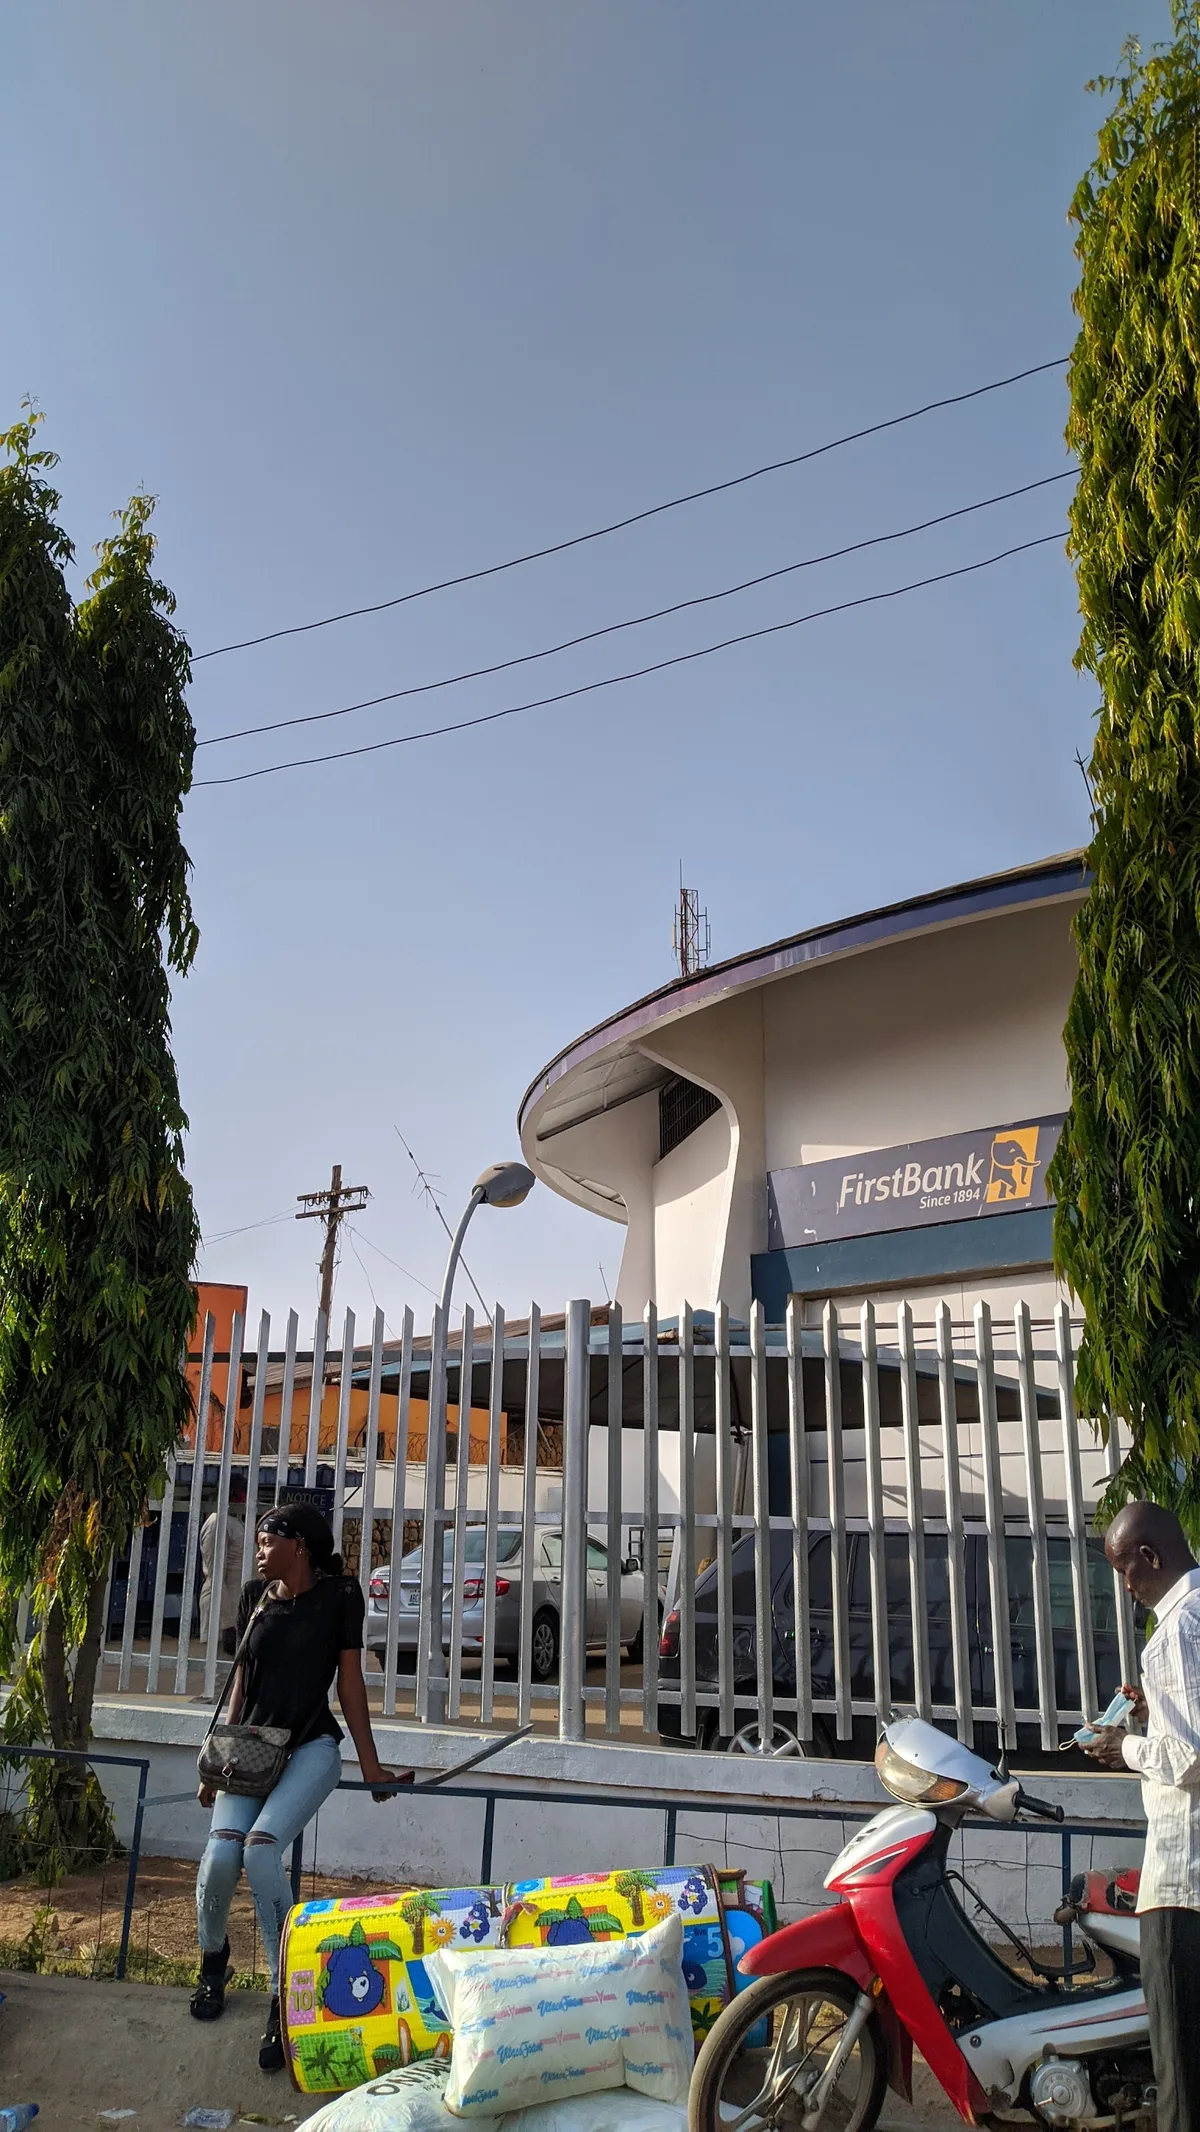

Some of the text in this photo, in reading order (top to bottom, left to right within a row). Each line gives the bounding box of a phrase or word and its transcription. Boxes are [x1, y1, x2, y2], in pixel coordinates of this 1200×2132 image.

[839, 1152, 985, 1208] FirstBank
[919, 1188, 981, 1209] Since 1894
[286, 1492, 327, 1506] NOTICE
[707, 1926, 724, 1958] 5
[290, 1989, 313, 2012] 10
